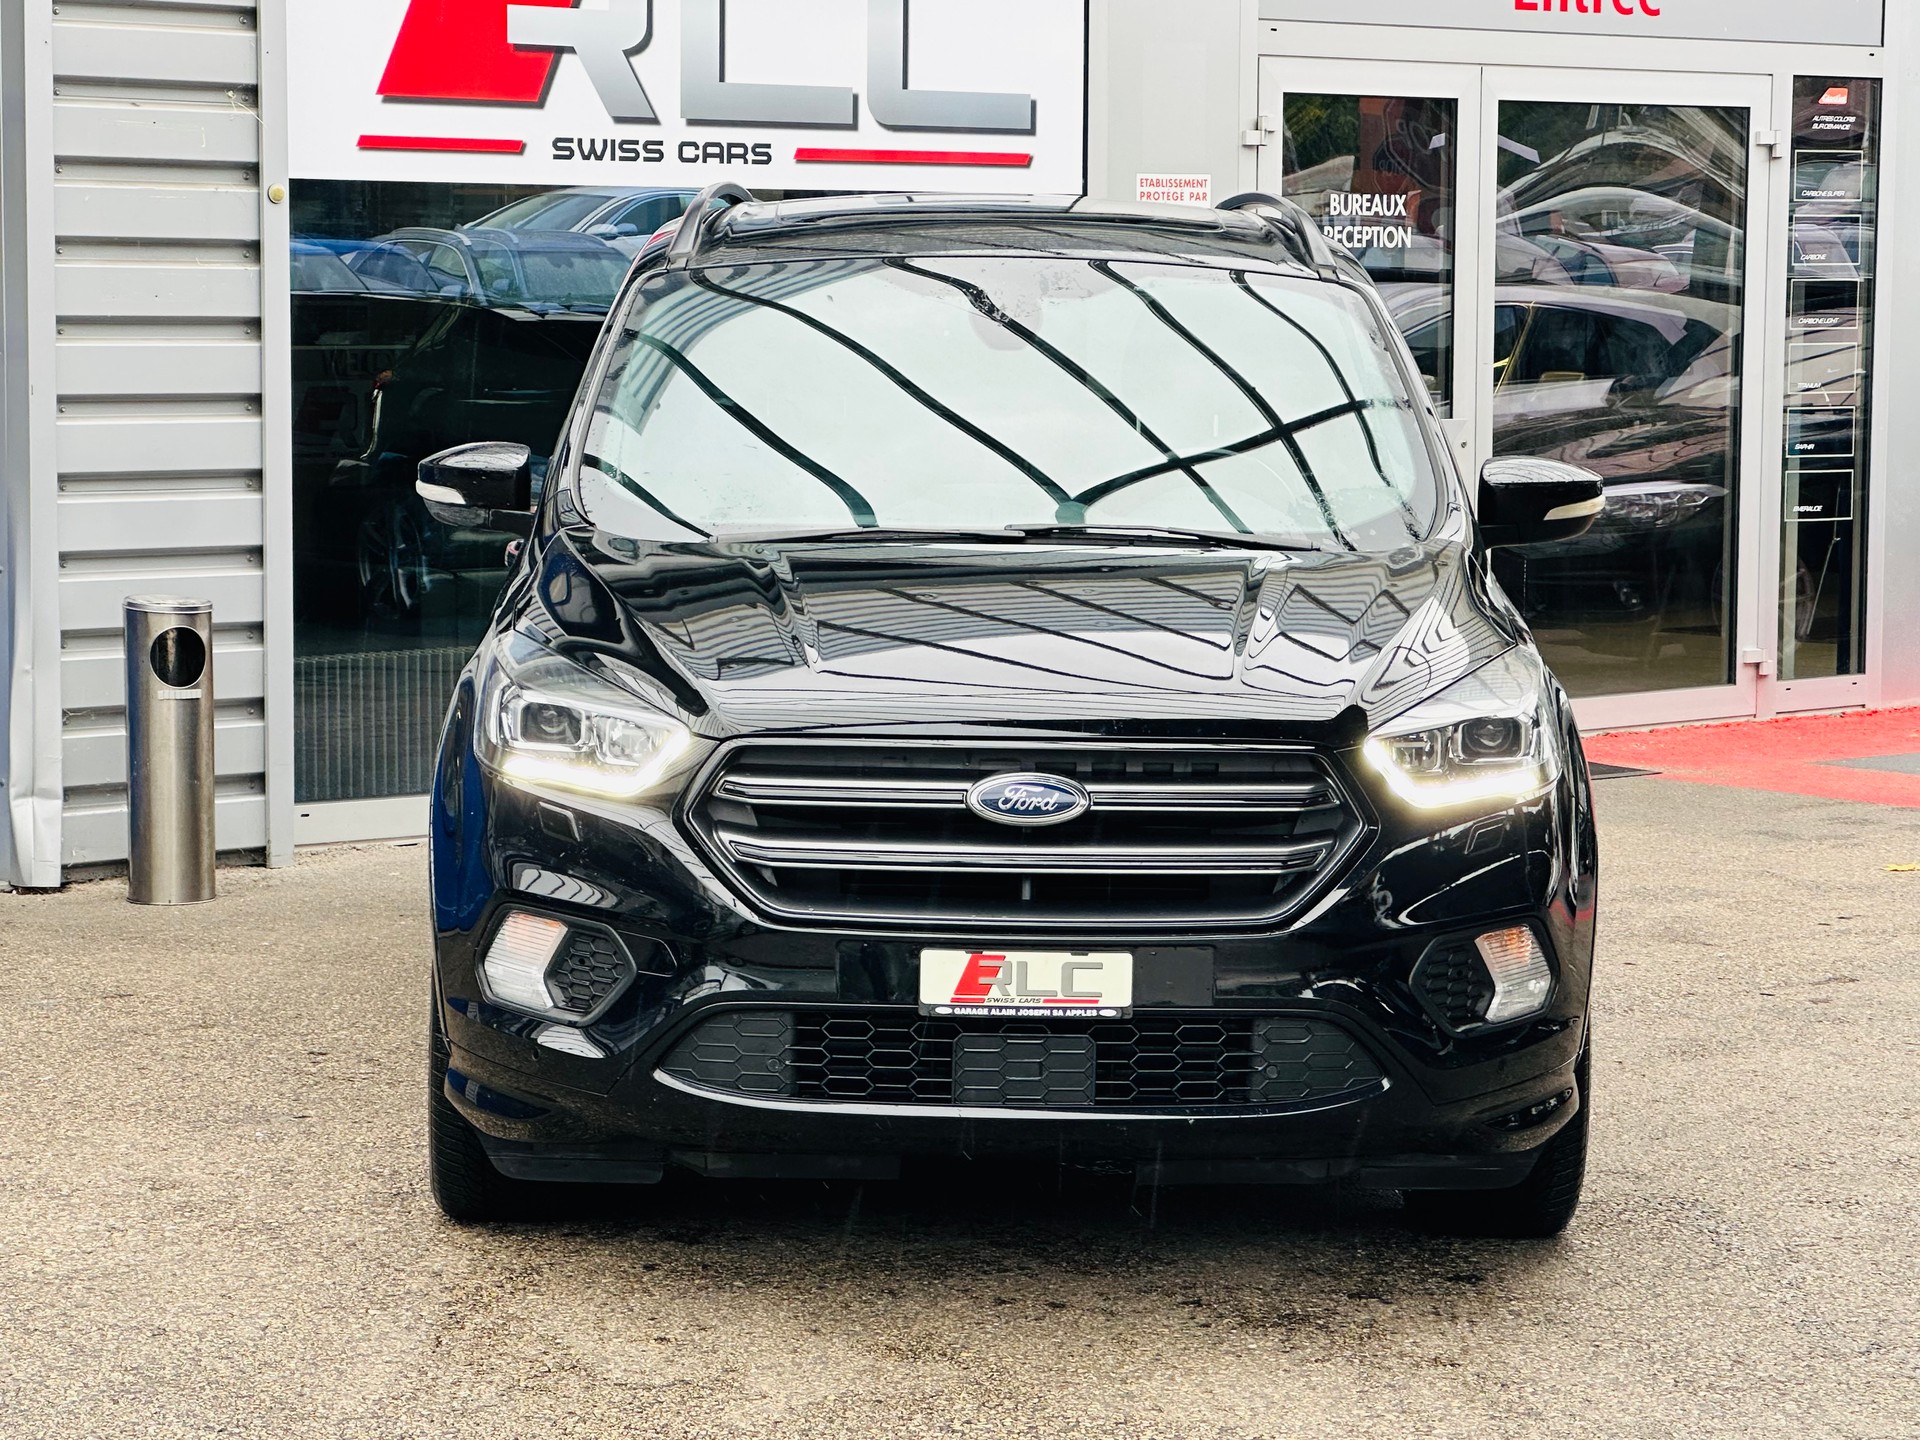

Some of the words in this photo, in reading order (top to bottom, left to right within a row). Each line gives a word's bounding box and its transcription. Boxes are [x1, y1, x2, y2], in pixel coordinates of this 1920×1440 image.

[551, 137, 665, 162] SWISS
[677, 140, 773, 165] CARS
[1139, 178, 1208, 189] ETABLISSEMENT
[1189, 191, 1208, 201] PAR
[1329, 193, 1407, 216] BUREAUX
[997, 785, 1059, 811] Ford
[954, 1007, 989, 1015] GARAGE
[990, 1008, 1016, 1016] ALAIN
[1052, 1009, 1064, 1017] SA
[1066, 1009, 1098, 1017] APPLES
